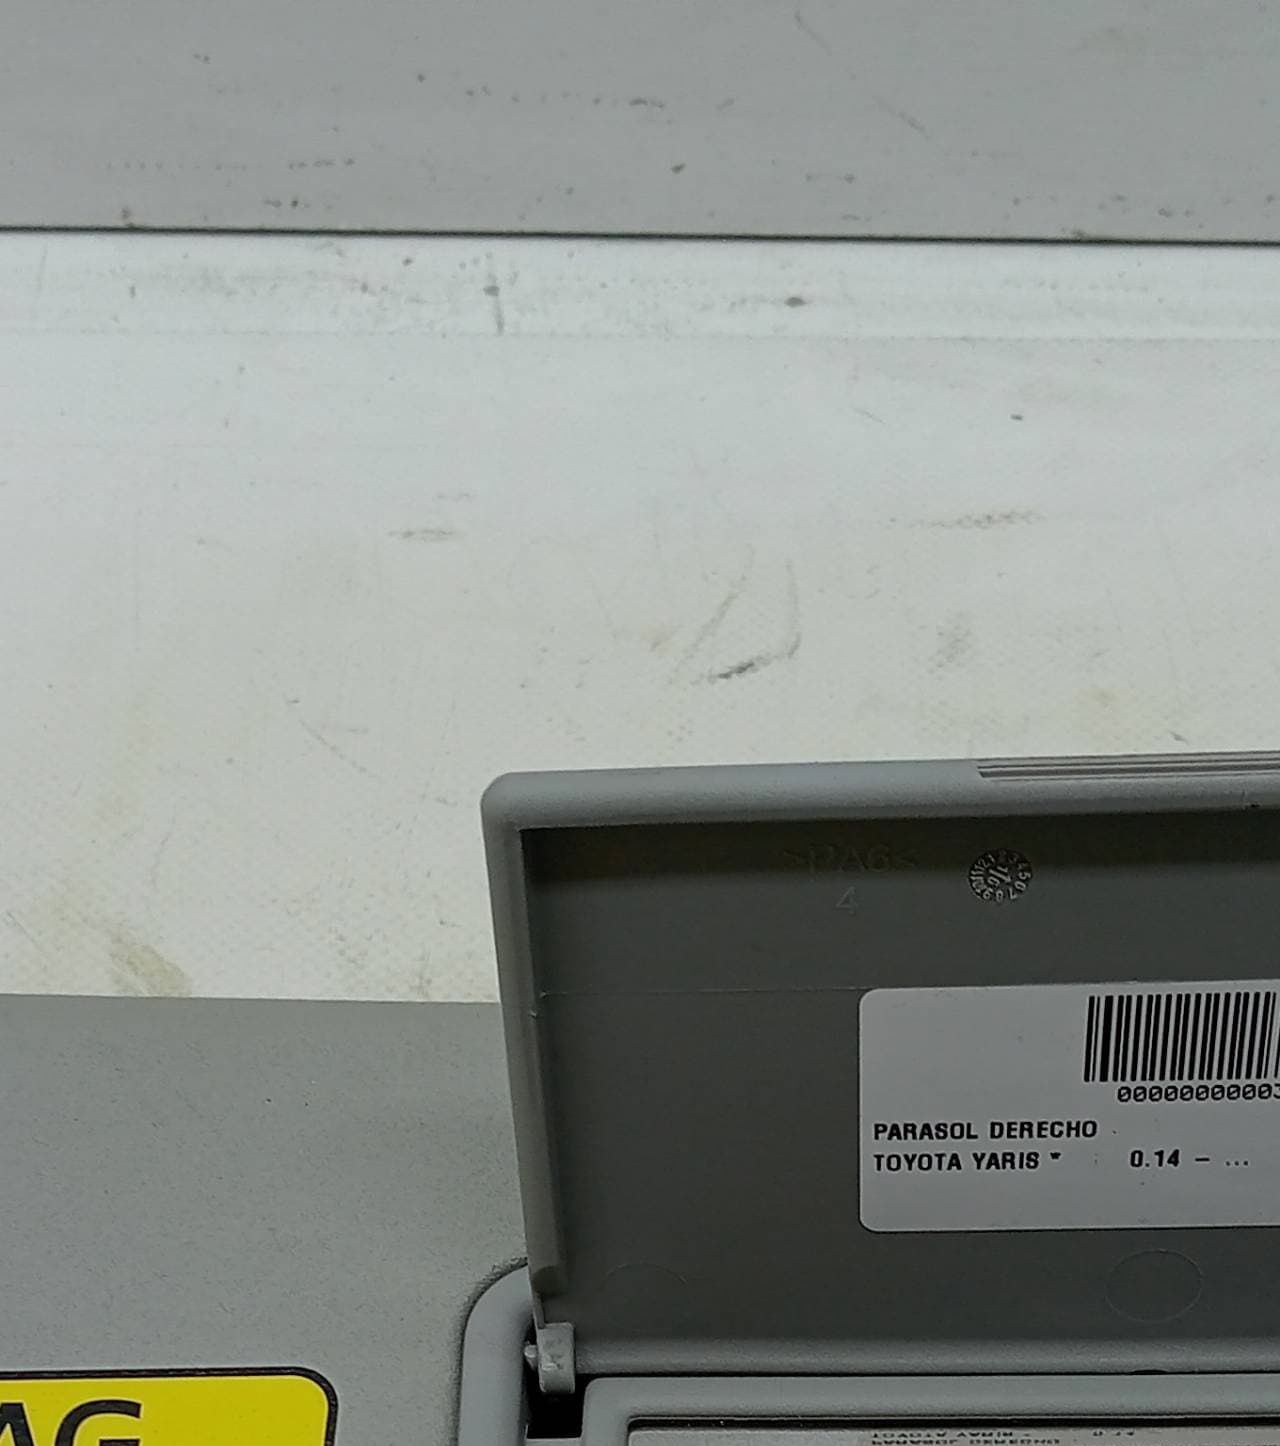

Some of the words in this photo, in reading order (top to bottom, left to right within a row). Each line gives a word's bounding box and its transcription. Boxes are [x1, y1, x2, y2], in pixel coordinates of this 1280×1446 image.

[873, 1121, 978, 1141] PARASOL
[989, 1119, 1098, 1140] DERECHO
[873, 1153, 962, 1171] TOYOTA
[972, 1151, 1040, 1170] YARIS
[1129, 1149, 1180, 1168] 0.14
